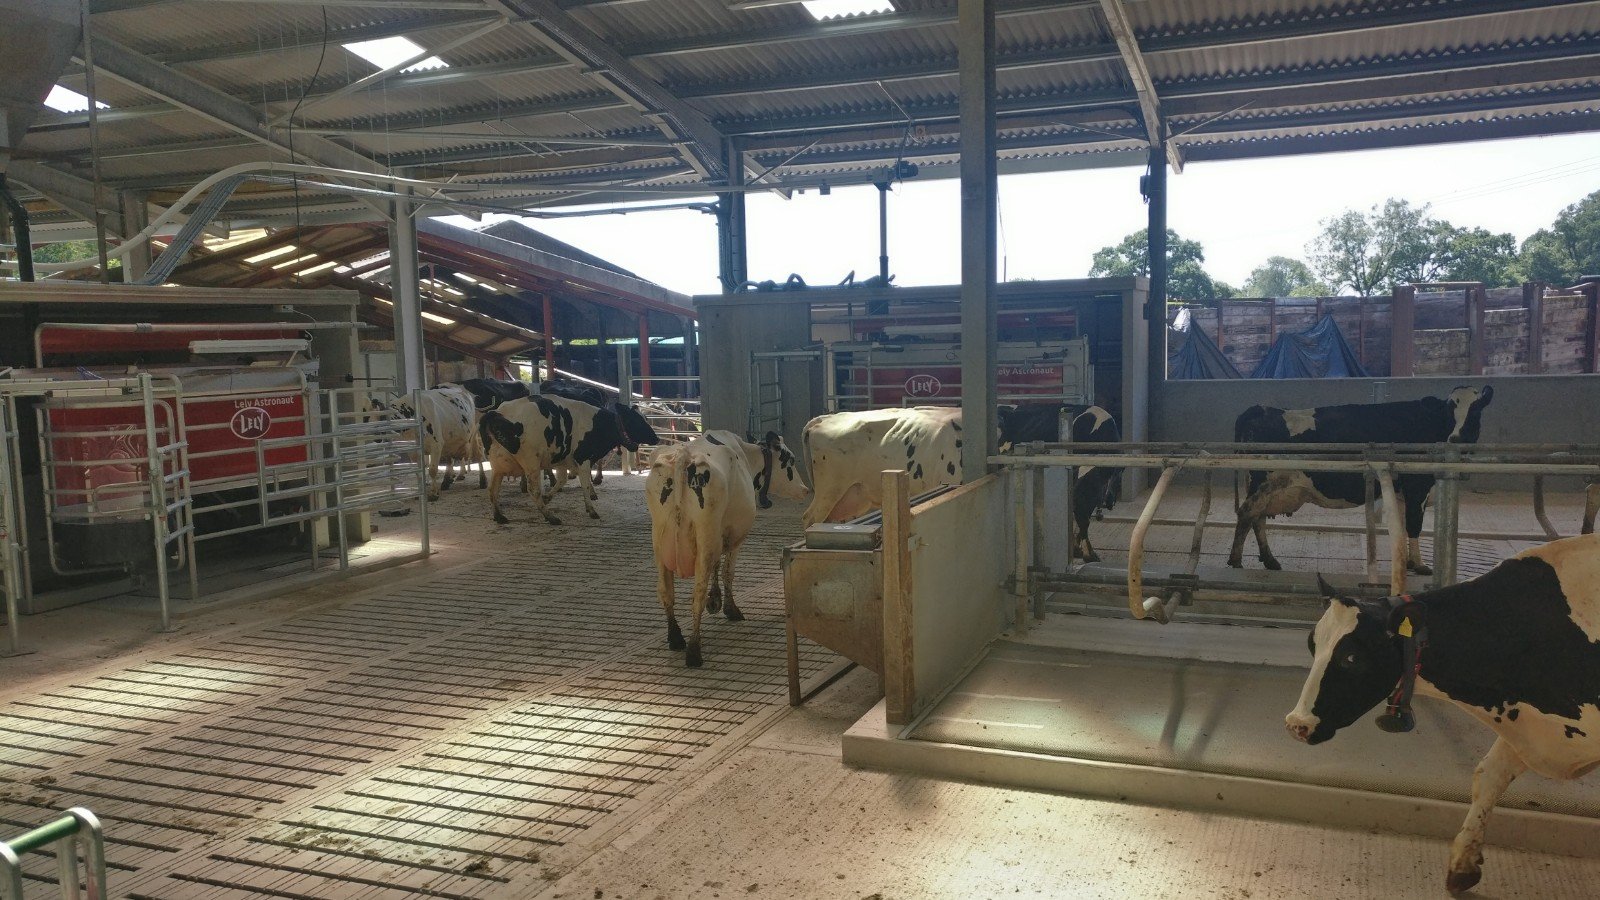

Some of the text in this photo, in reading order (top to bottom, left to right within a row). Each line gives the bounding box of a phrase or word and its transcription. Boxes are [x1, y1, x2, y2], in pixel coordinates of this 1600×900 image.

[1012, 367, 1054, 375] Astronaut
[912, 379, 933, 394] LELY
[254, 396, 294, 407] Astronaut
[241, 412, 263, 433] LELY
